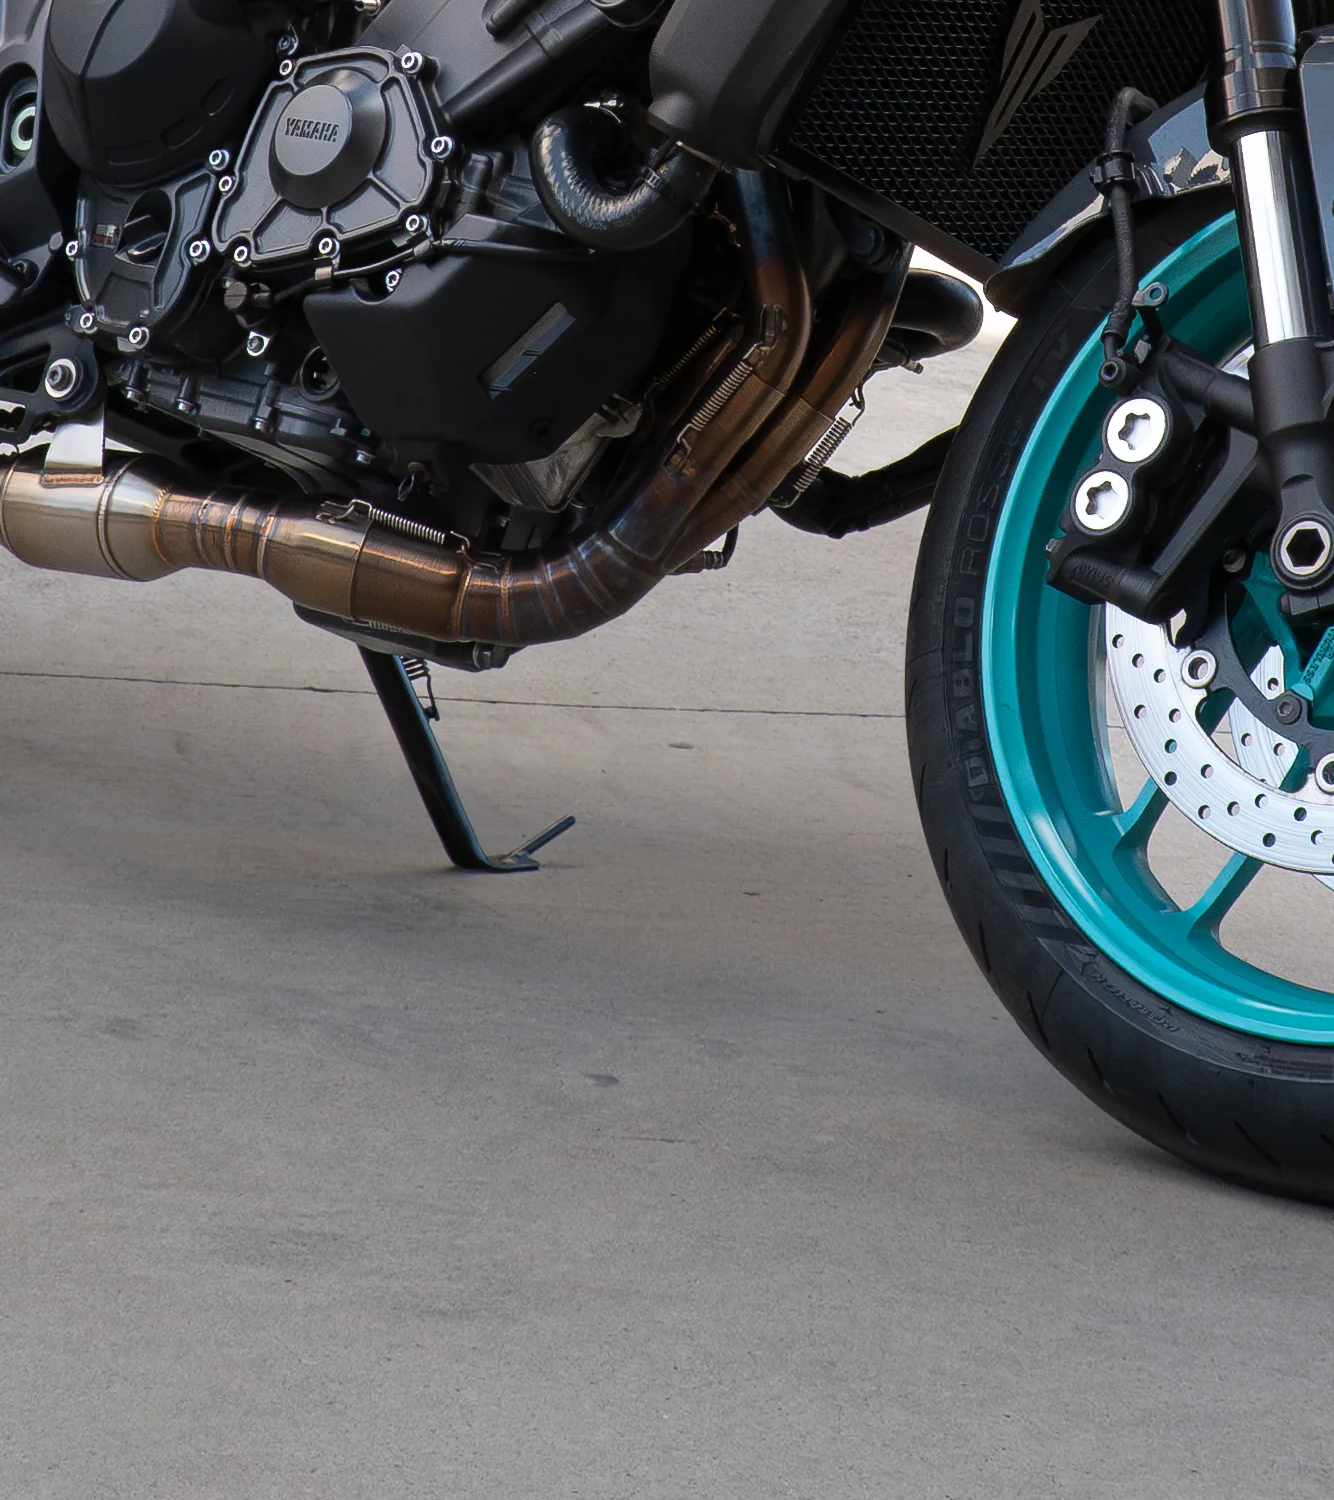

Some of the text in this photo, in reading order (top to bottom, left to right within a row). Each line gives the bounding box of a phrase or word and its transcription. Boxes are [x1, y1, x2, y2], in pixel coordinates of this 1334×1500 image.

[284, 117, 340, 143] YAMAHA
[960, 420, 1021, 576] ROSSO
[953, 597, 991, 788] DIABLO
